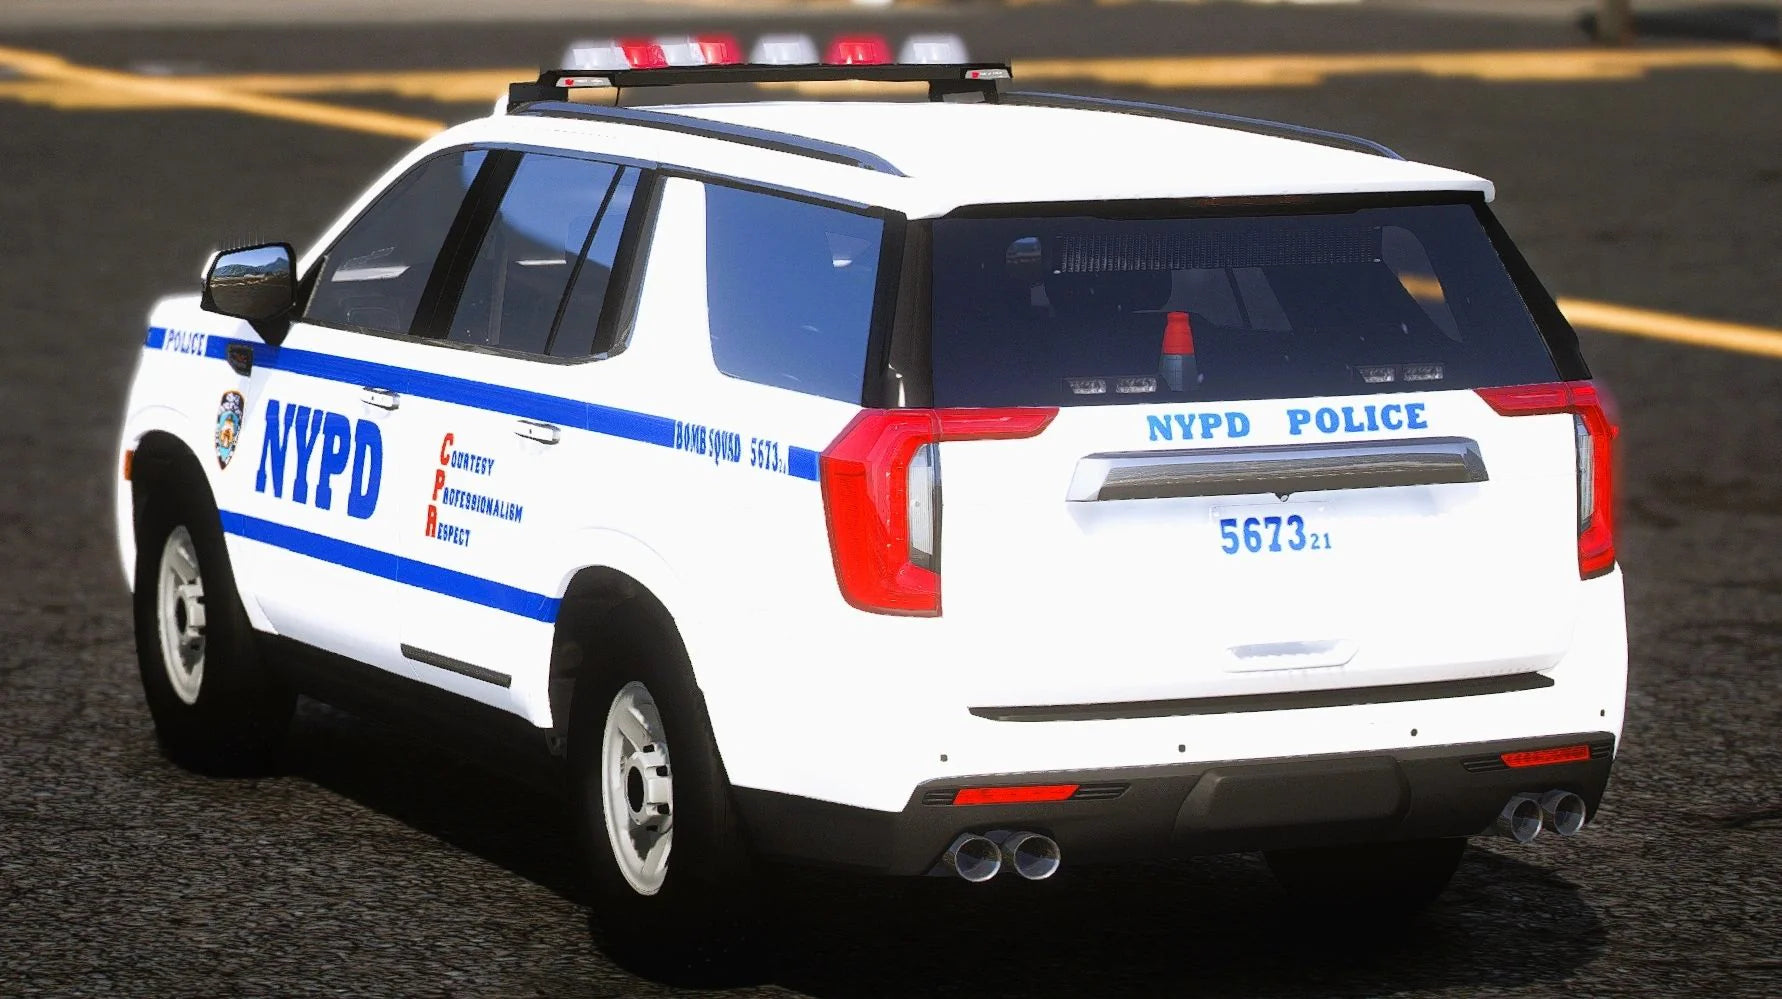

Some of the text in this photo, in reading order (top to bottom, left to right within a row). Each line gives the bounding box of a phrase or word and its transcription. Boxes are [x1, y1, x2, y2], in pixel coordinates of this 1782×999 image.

[165, 328, 205, 356] POLICE
[675, 421, 707, 455] BOMB
[708, 428, 742, 467] SQUAD
[1146, 403, 1428, 441] NYPD POLICE
[255, 399, 383, 520] NYPD
[440, 432, 495, 476] COURTESY
[432, 469, 524, 523] PROFESSIONALISM
[425, 504, 471, 547] RESPECT
